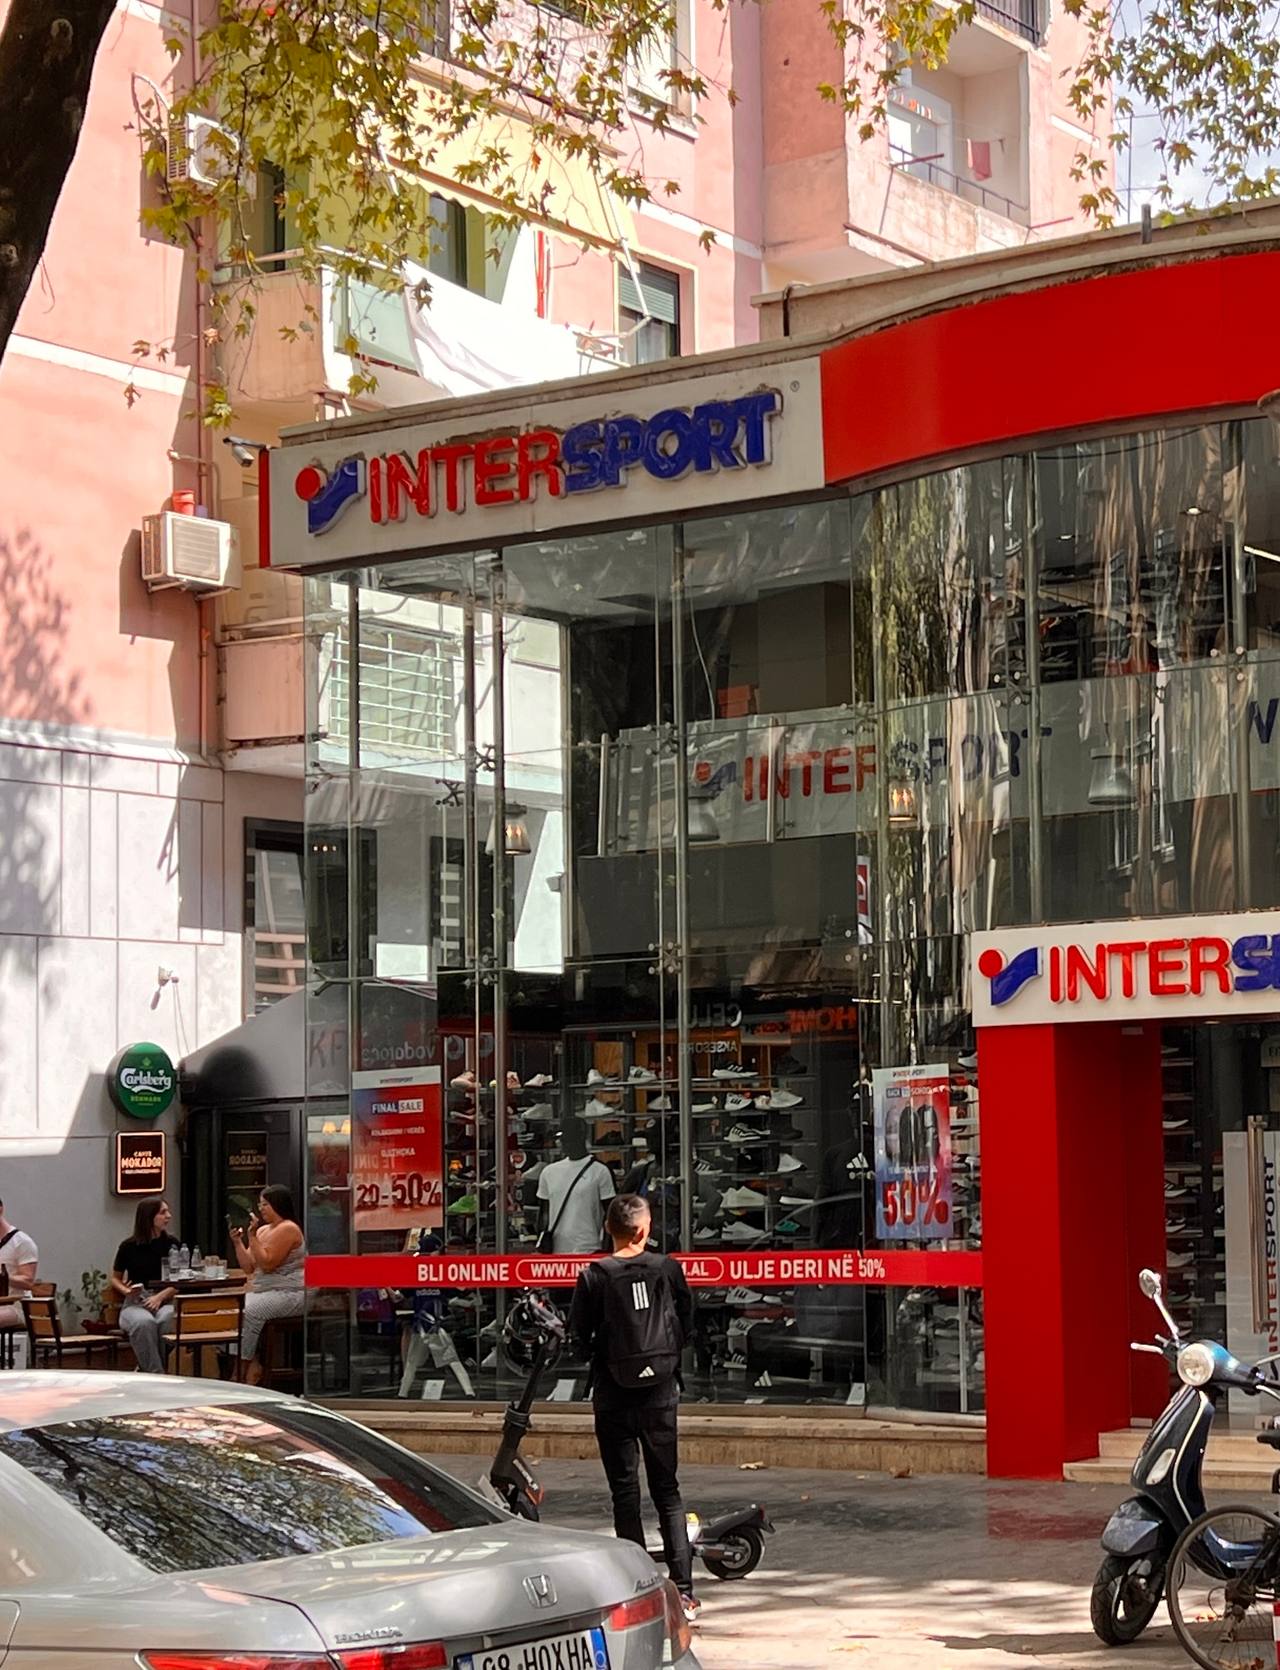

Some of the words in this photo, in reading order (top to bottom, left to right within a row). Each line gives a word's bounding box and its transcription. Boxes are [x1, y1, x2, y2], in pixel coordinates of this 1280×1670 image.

[370, 391, 779, 524] INTERSPORT
[120, 1067, 171, 1093] Carlsberg
[372, 1103, 398, 1114] FINAL
[400, 1100, 422, 1112] SALE
[121, 1157, 162, 1168] MOKADOR
[883, 1179, 949, 1227] 50%
[418, 1263, 443, 1282] BLI
[448, 1263, 509, 1282] ONLINE
[730, 1259, 775, 1280] ULJE
[780, 1259, 822, 1279] DERI
[828, 1253, 853, 1278] NË
[859, 1258, 885, 1279] 50%
[1264, 1157, 1278, 1353] INTERSPORT
[523, 1636, 593, 1670] HOXHA
